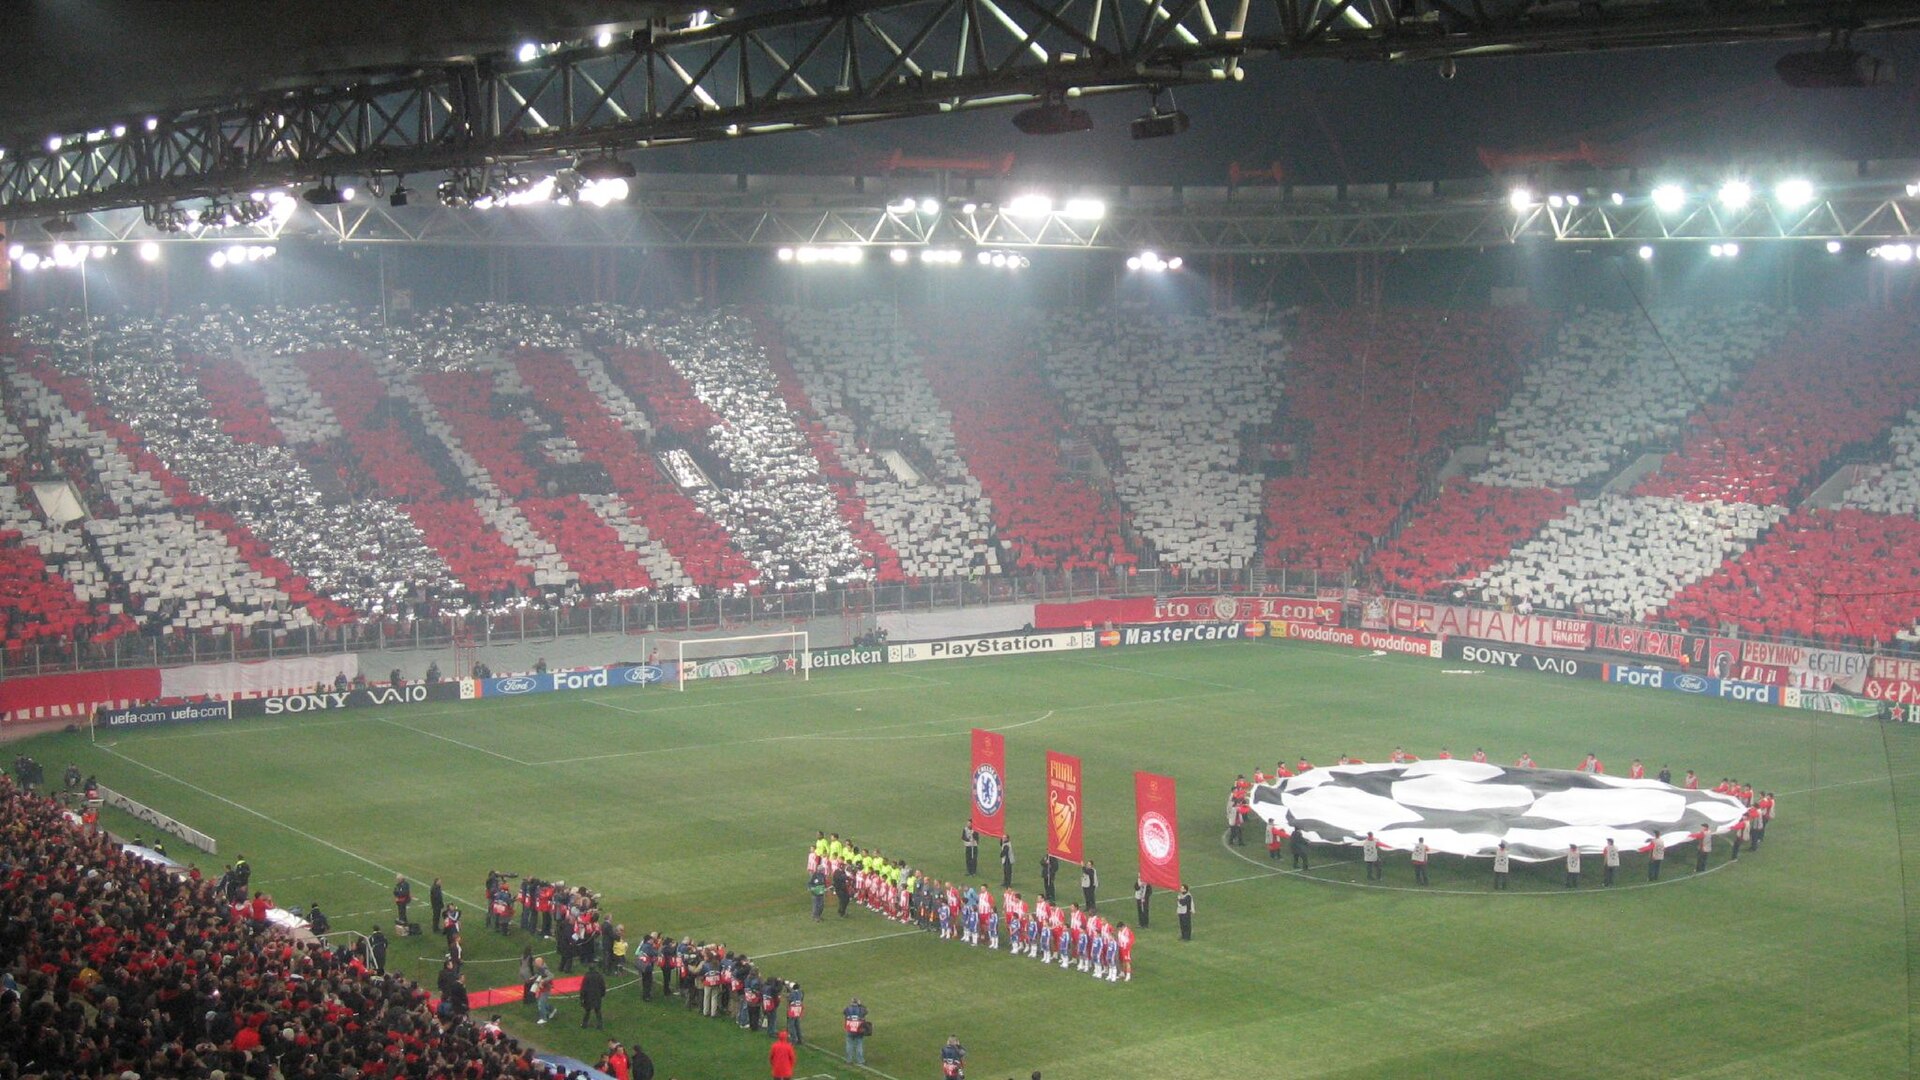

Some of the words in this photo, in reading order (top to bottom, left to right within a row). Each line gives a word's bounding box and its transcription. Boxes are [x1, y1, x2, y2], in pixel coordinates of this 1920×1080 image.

[1125, 623, 1239, 645] MasterCard
[1556, 619, 1587, 631] BYRON
[931, 635, 1053, 657] PlayStation
[1301, 624, 1354, 644] vodafone
[1371, 633, 1427, 655] vodafone
[1693, 638, 1705, 662] 7
[800, 649, 882, 669] Heineken
[1462, 646, 1521, 667] SONY
[1533, 656, 1577, 675] VAIO
[504, 678, 529, 691] Ford
[553, 669, 608, 690] Ford
[1616, 666, 1662, 688] Ford
[1680, 677, 1701, 690] Ford
[1720, 679, 1769, 703] Ford
[265, 692, 350, 714] SONY
[367, 685, 427, 704] VAIO
